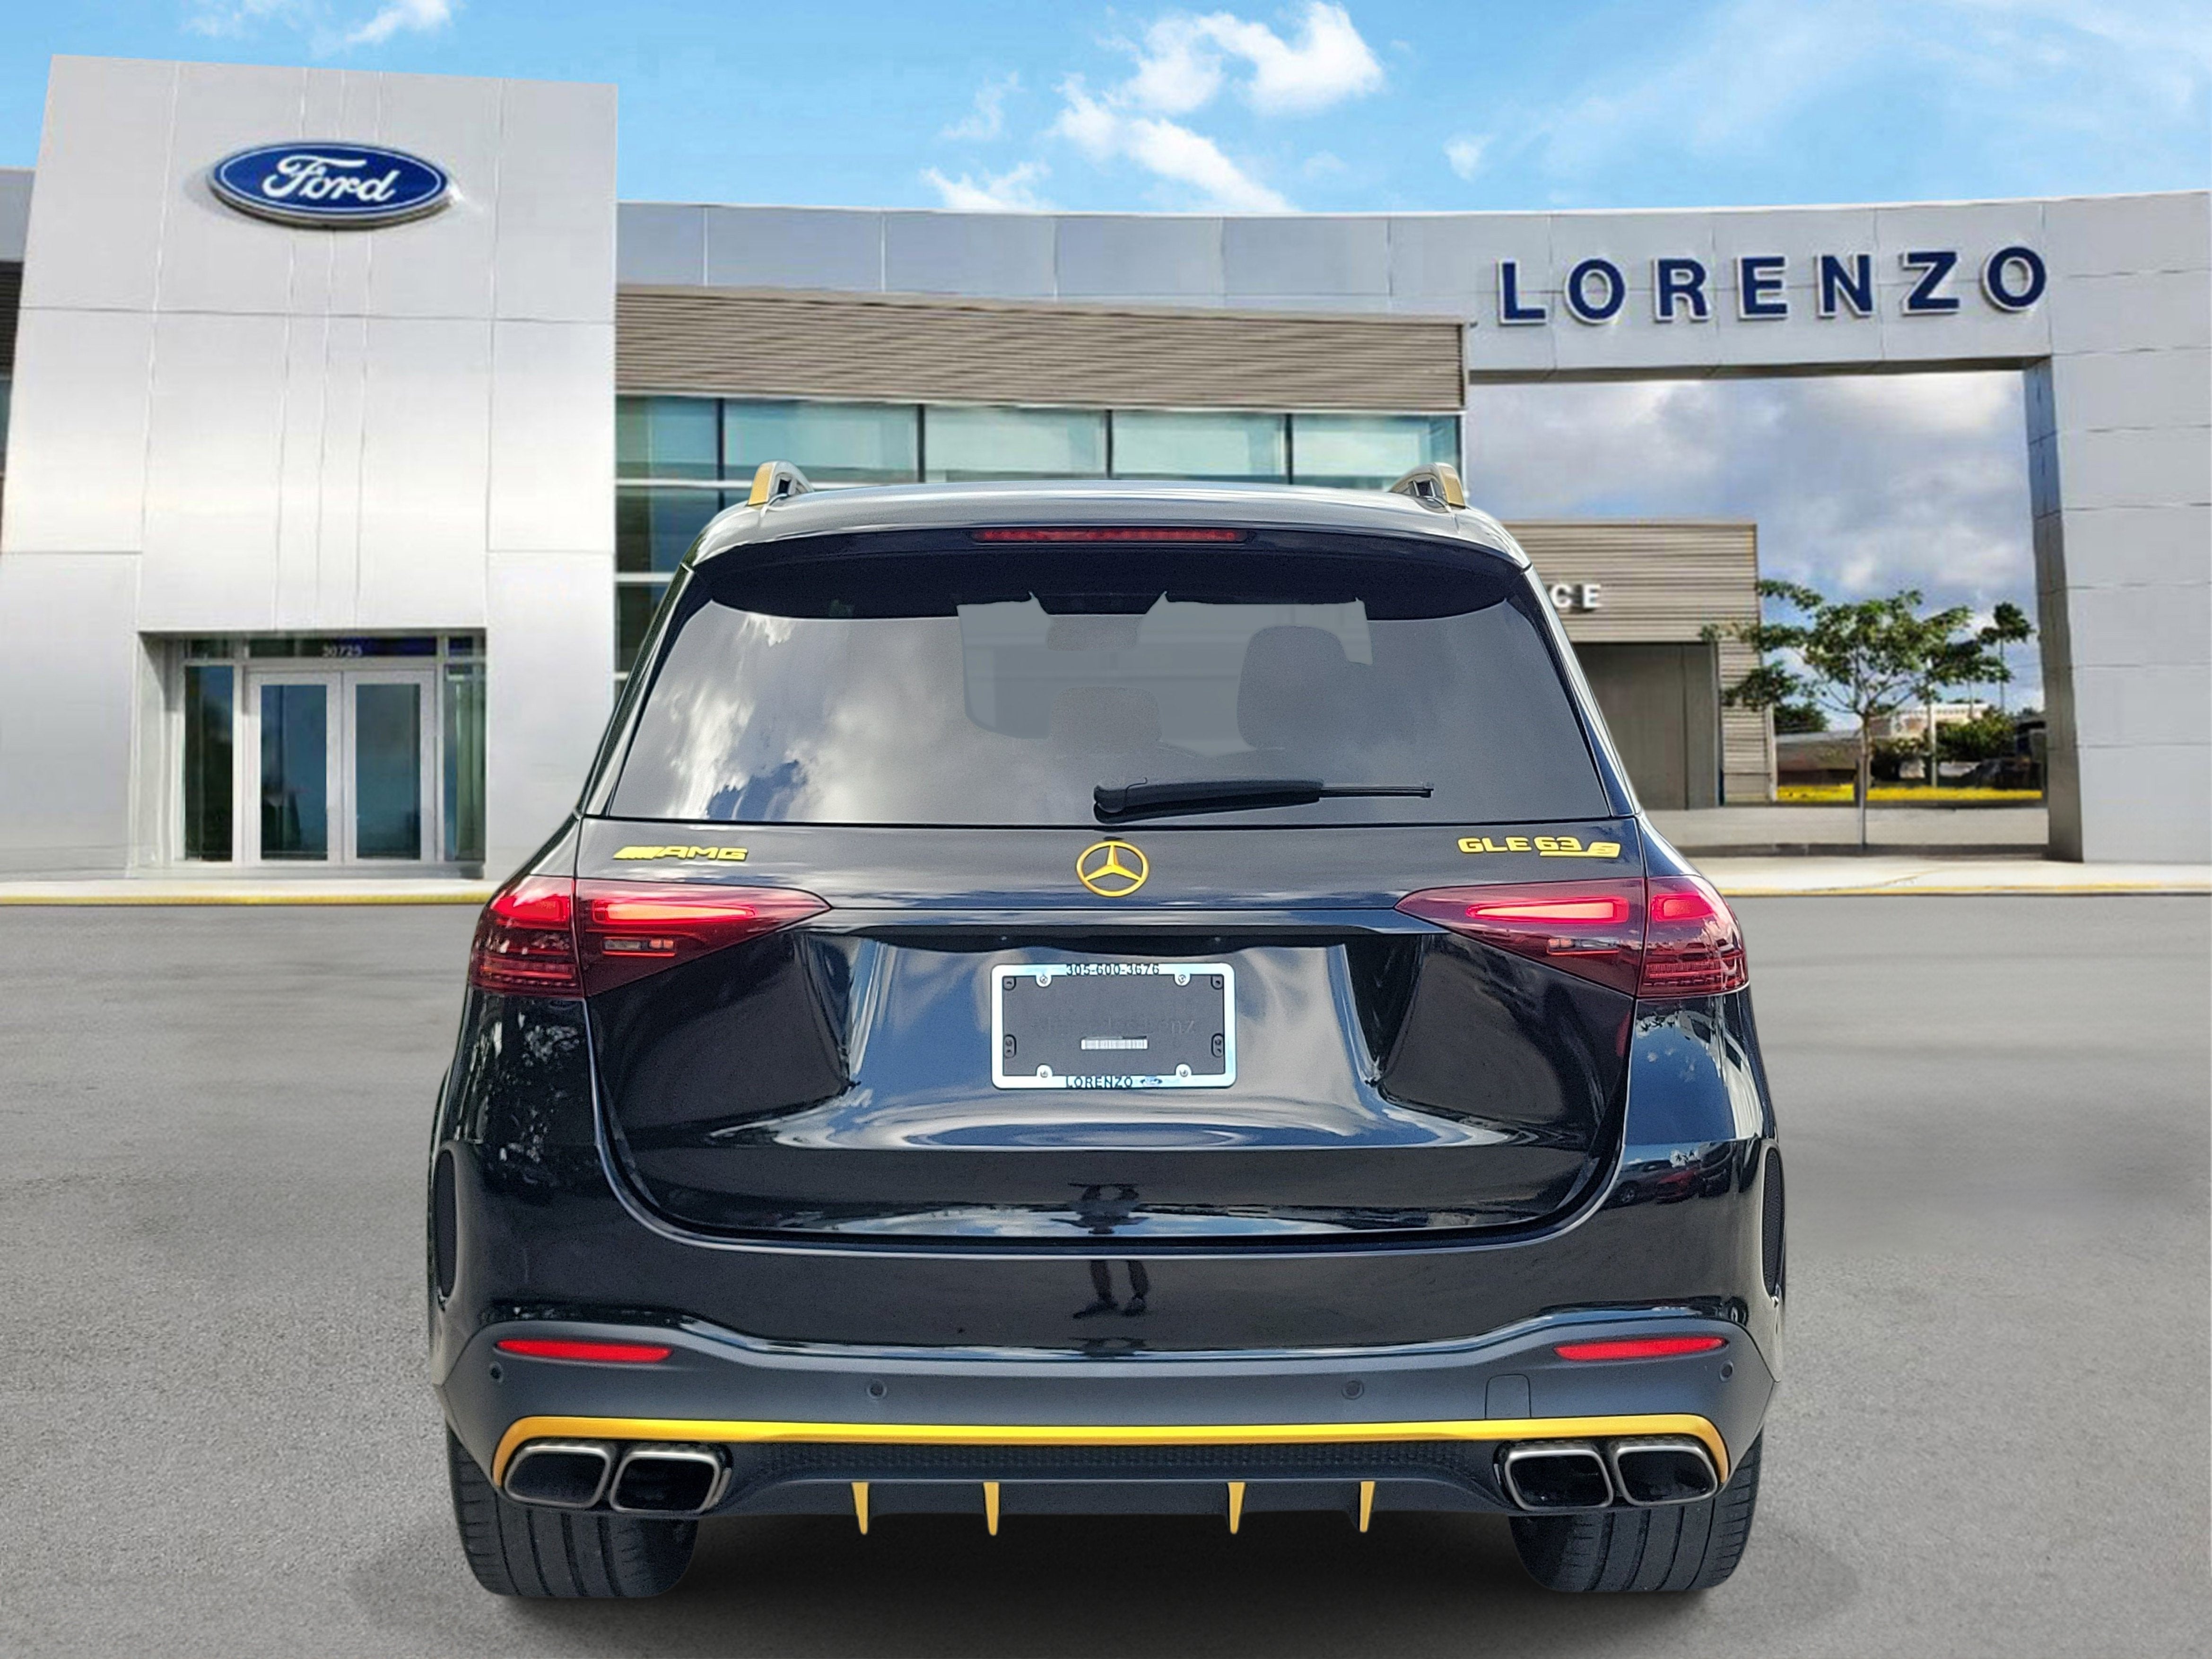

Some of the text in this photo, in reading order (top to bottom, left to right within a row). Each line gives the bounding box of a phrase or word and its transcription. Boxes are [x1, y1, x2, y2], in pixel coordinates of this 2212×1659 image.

[262, 155, 400, 200] Ford
[1499, 246, 2047, 322] LORENZO
[655, 846, 748, 861] AMG
[1066, 964, 1159, 975] 305-600-3676
[1066, 1076, 1133, 1088] LORENZO
